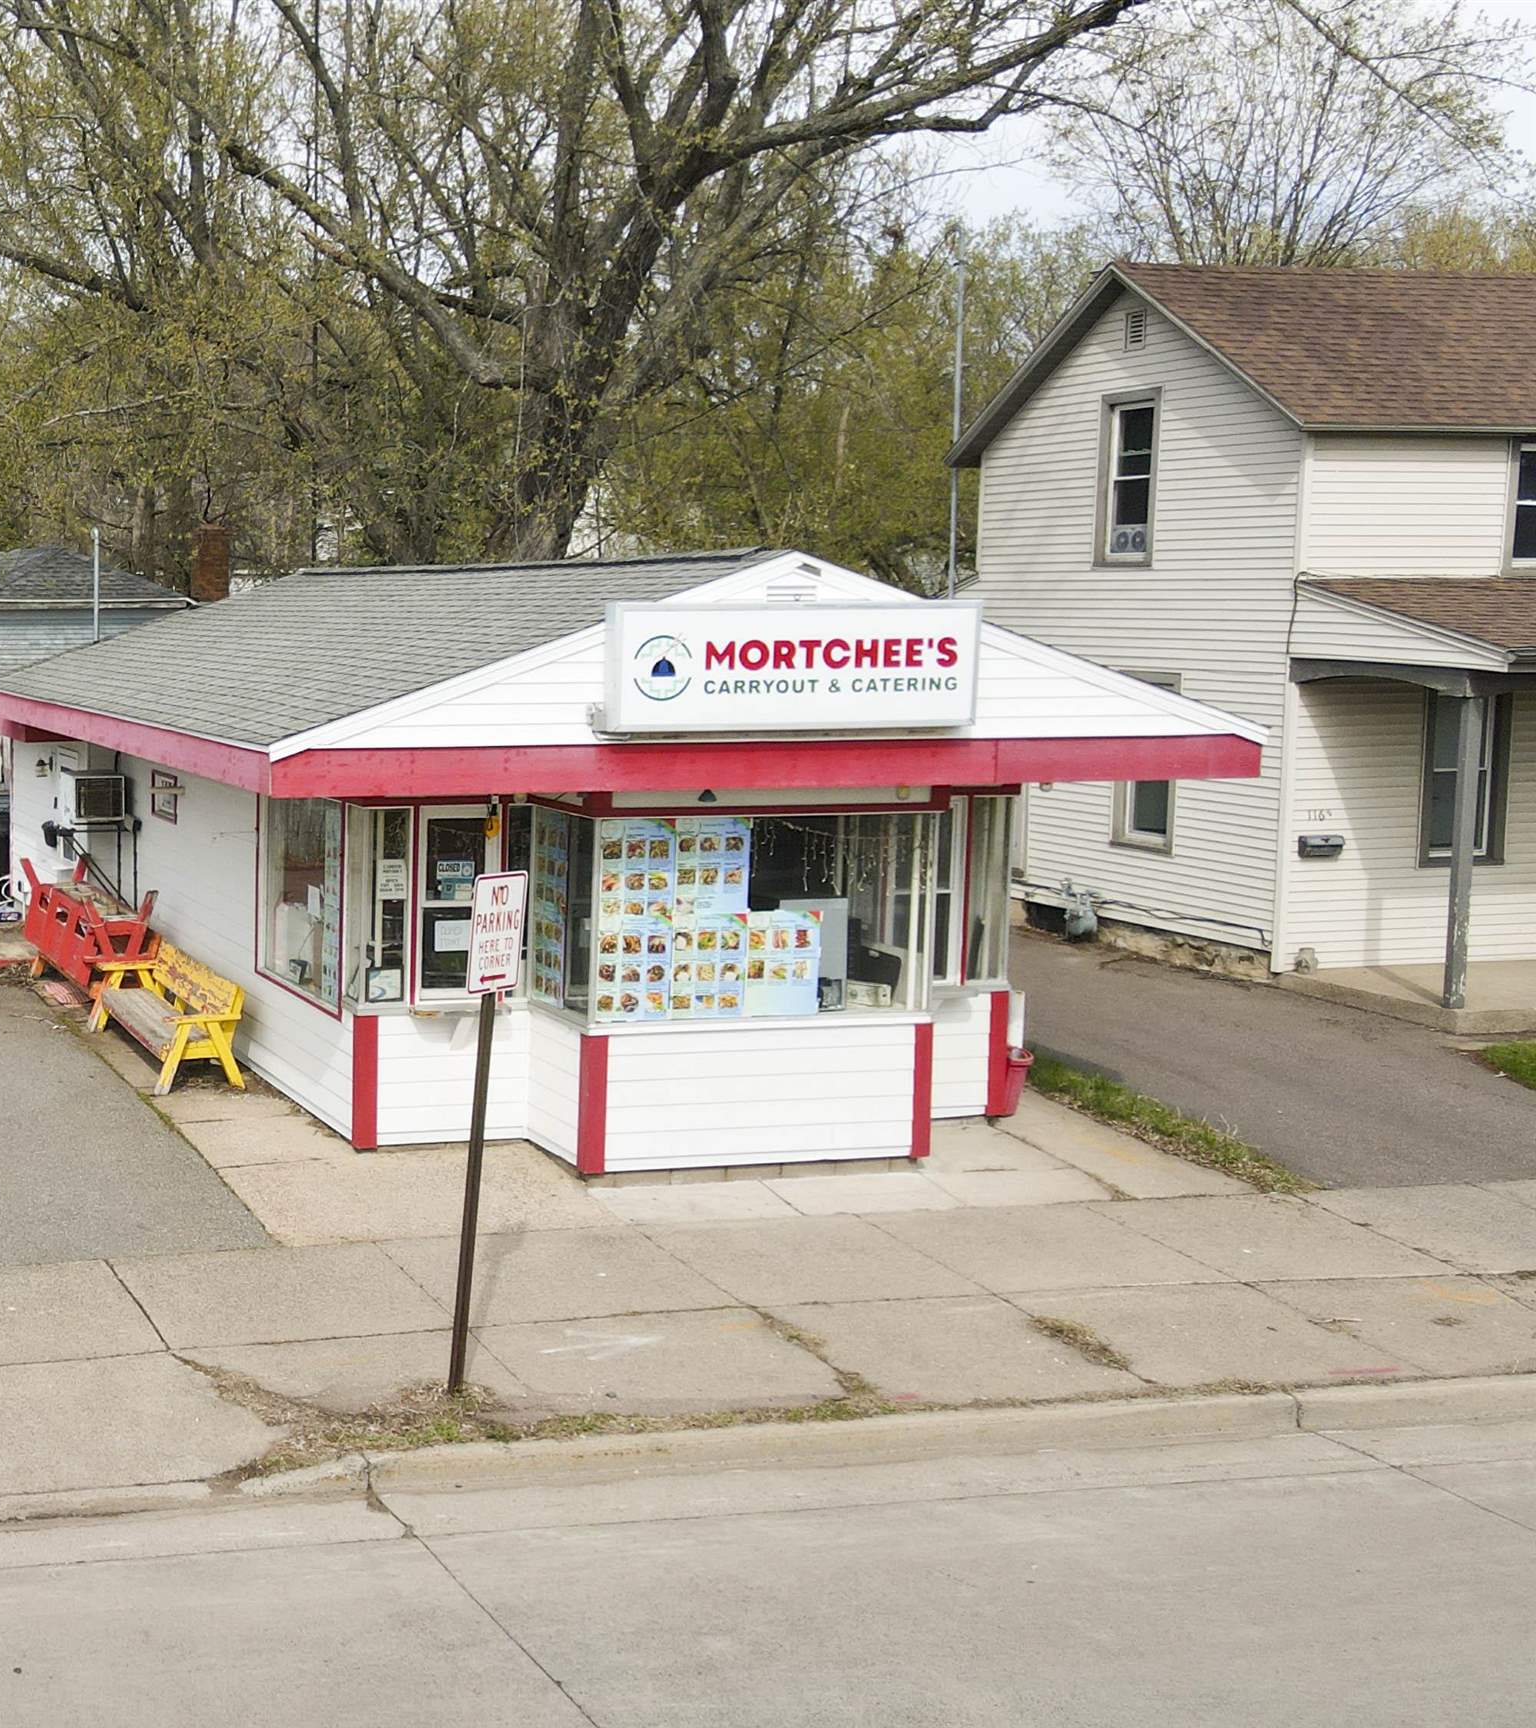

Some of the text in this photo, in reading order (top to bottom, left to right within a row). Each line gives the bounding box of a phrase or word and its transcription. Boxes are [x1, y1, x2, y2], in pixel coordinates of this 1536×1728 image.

[705, 637, 958, 671] MORTCHEE'S
[704, 676, 958, 694] CARRYOUT & CATERING
[438, 863, 461, 873] CLOSED
[490, 885, 510, 906] NO
[475, 909, 520, 935] PARKING
[478, 938, 500, 955] HERE
[504, 936, 514, 951] TO
[478, 953, 512, 971] CORNER
